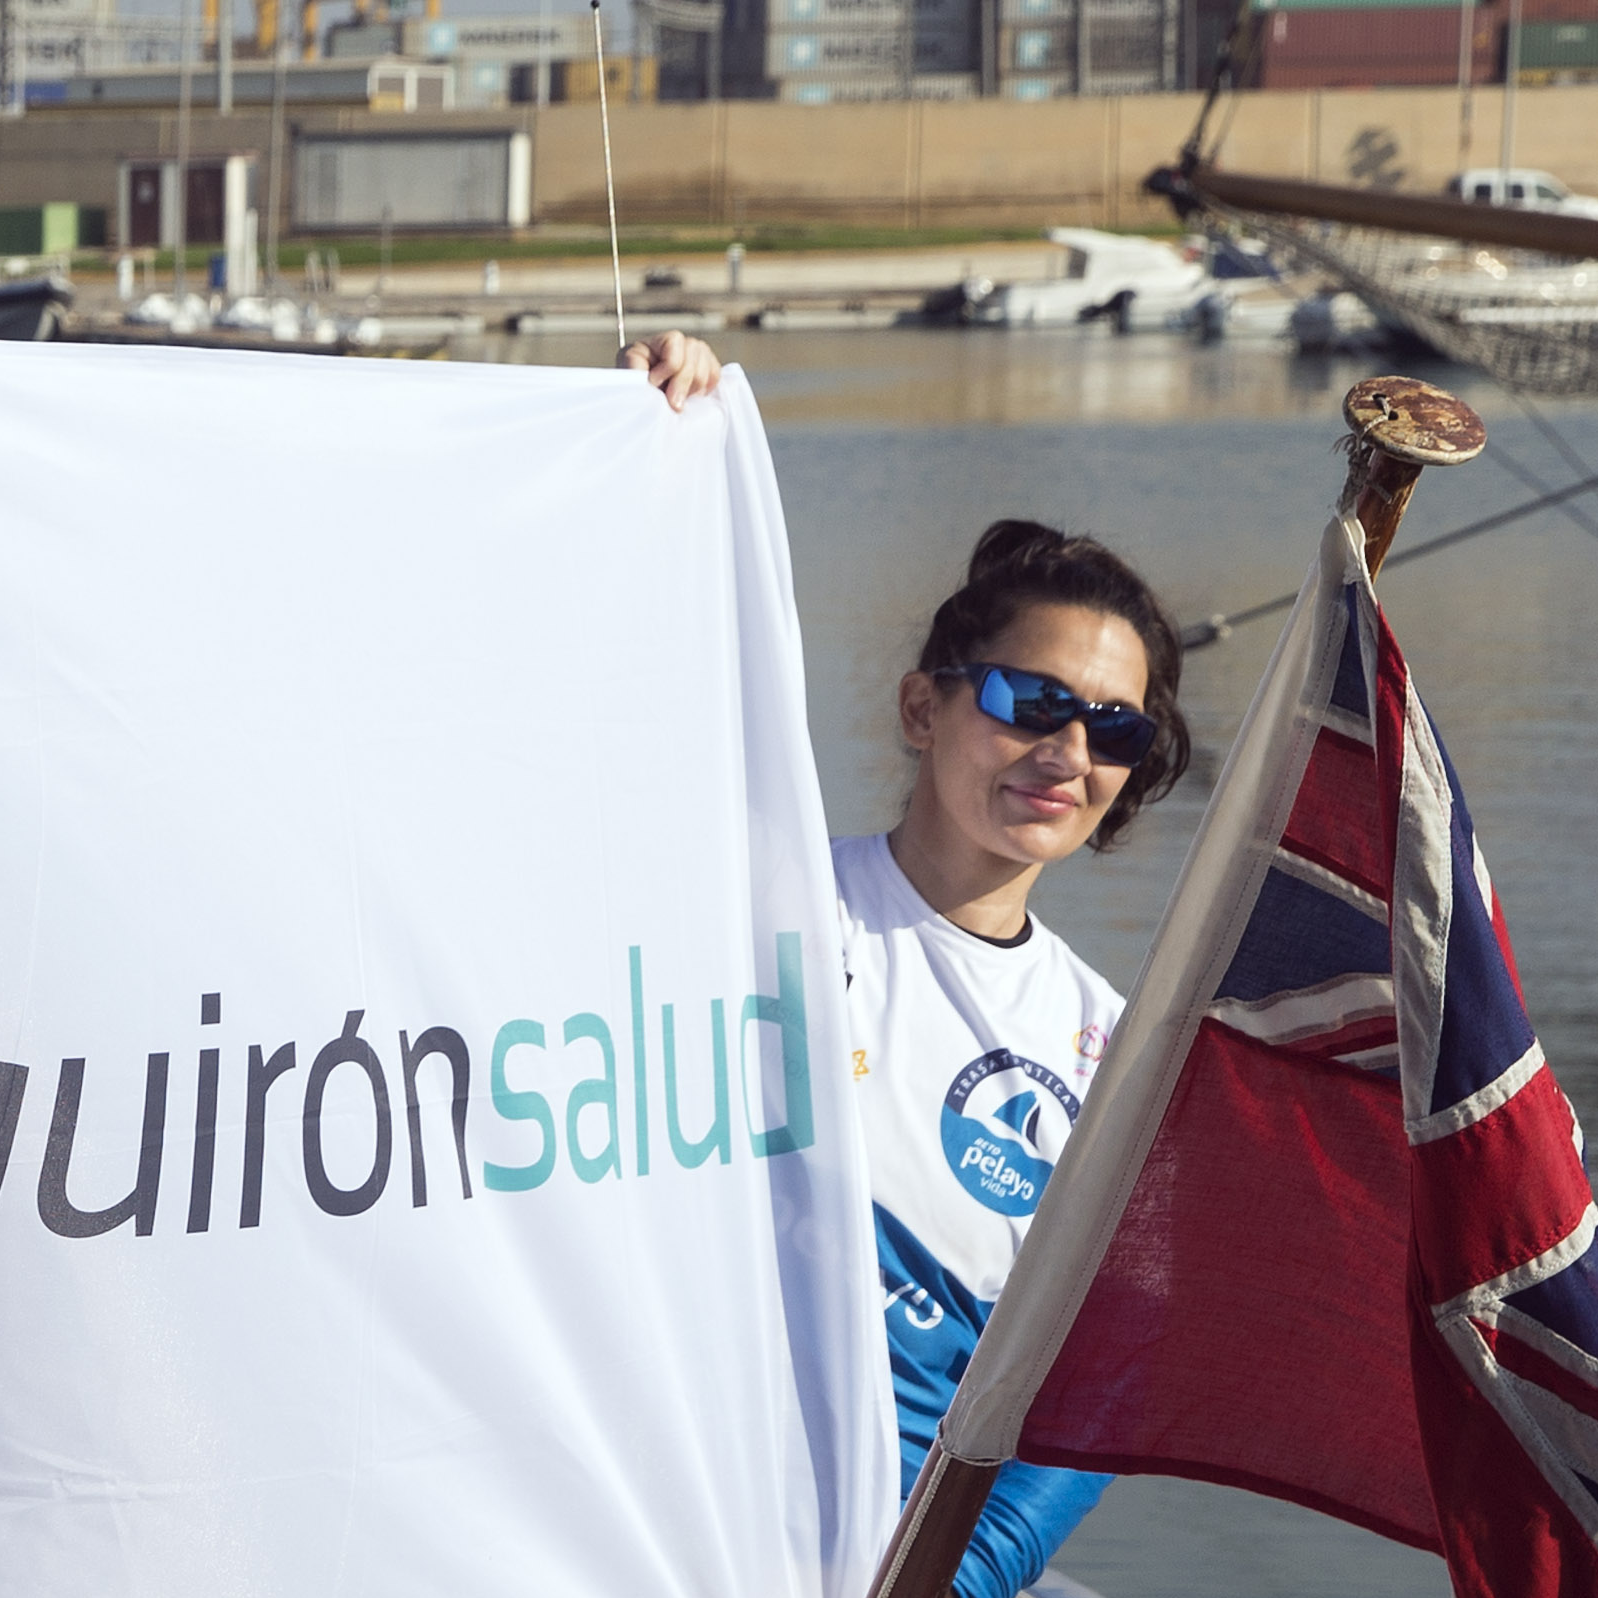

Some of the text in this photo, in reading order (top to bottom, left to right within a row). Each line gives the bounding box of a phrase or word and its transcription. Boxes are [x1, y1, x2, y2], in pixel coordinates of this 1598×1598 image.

[973, 1136, 1002, 1156] RETO
[960, 1145, 1035, 1200] pelayo
[980, 1176, 1007, 1198] vida
